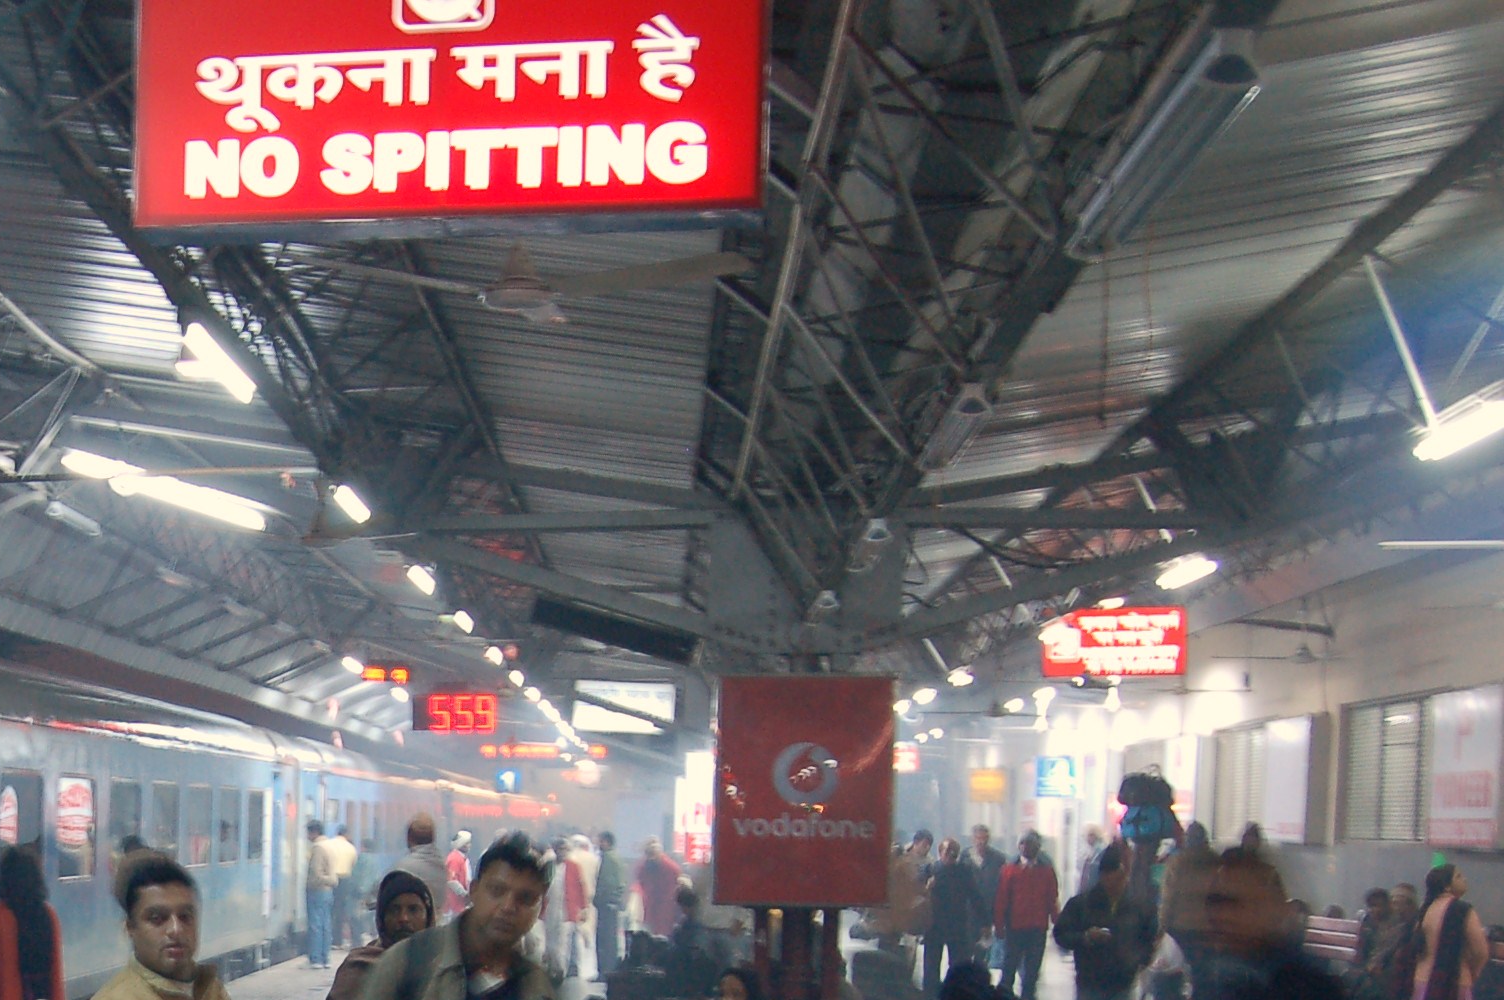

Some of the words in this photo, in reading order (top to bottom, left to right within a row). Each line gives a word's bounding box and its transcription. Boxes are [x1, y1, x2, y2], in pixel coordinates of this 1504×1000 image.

[195, 47, 437, 133] थूकना
[450, 39, 614, 103] मना
[630, 13, 700, 103] है
[184, 136, 300, 198] NO
[319, 120, 709, 194] SPITTING
[732, 812, 877, 840] vodafone
